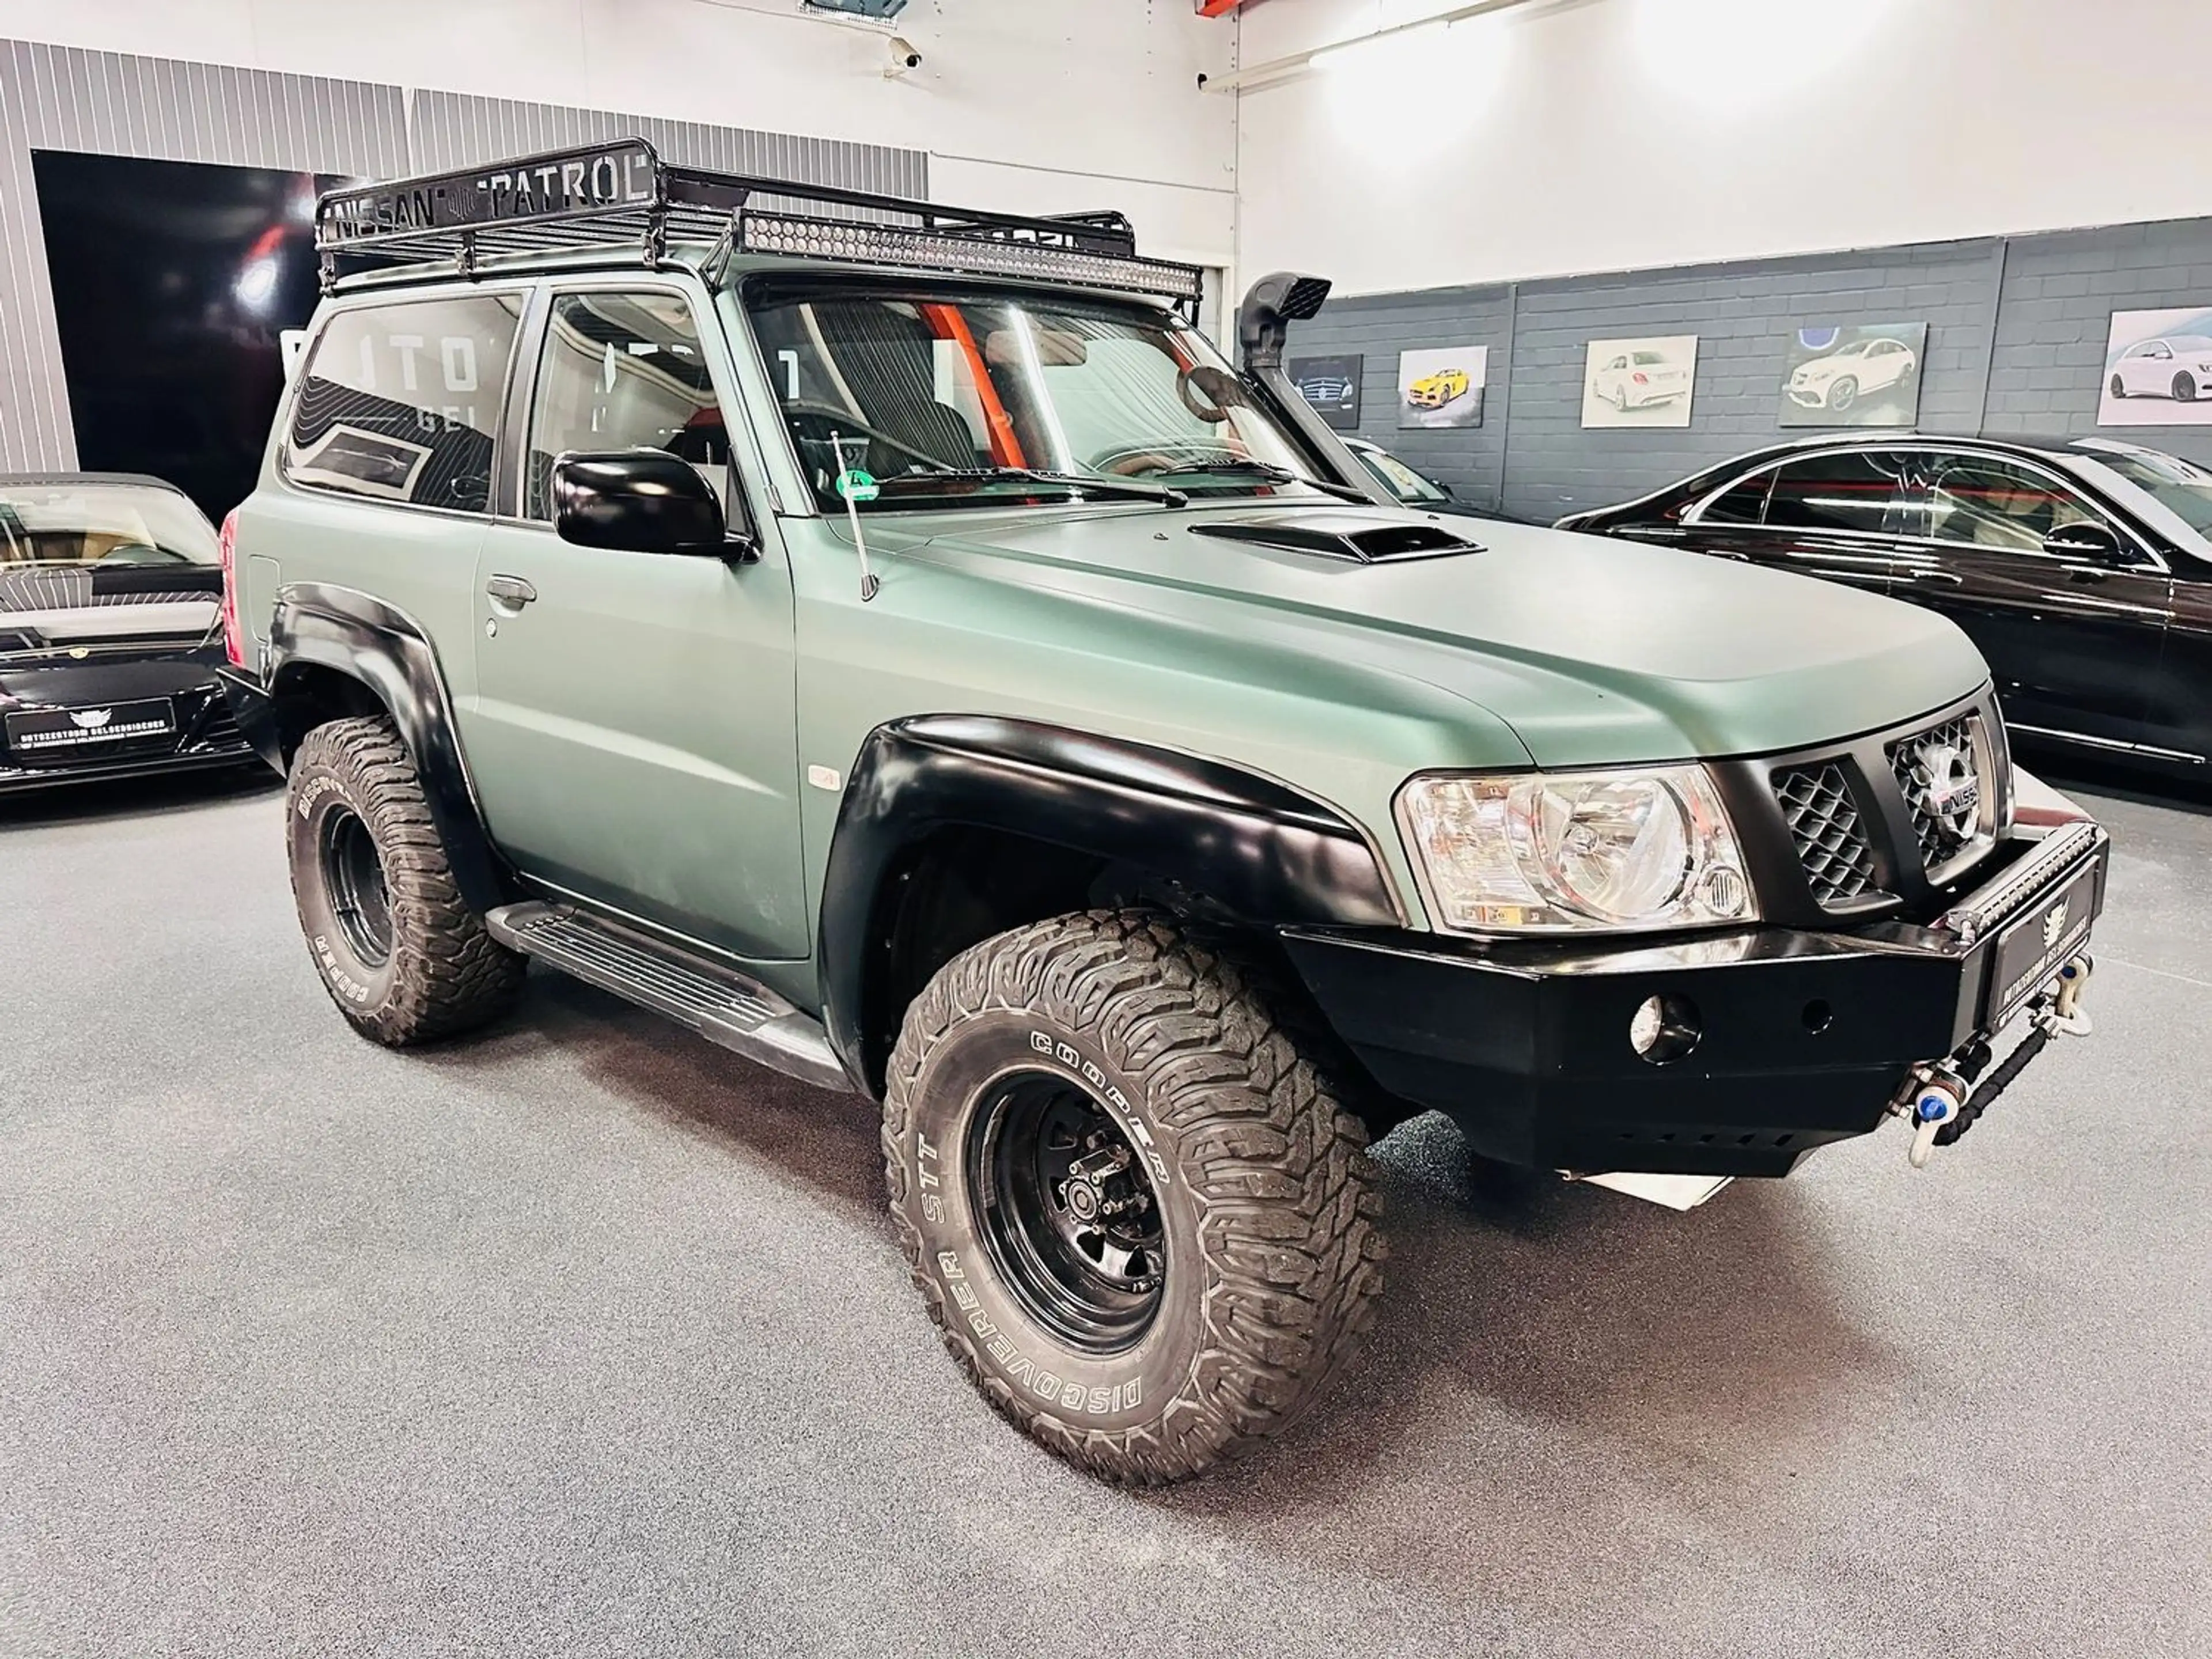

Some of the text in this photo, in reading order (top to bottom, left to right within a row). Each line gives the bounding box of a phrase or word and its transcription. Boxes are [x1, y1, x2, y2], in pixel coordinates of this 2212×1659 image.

[335, 154, 649, 240] NISSAN PATROL
[1030, 1030, 1171, 1184] COOPER
[918, 1132, 1142, 1415] DISCOVERER STT
